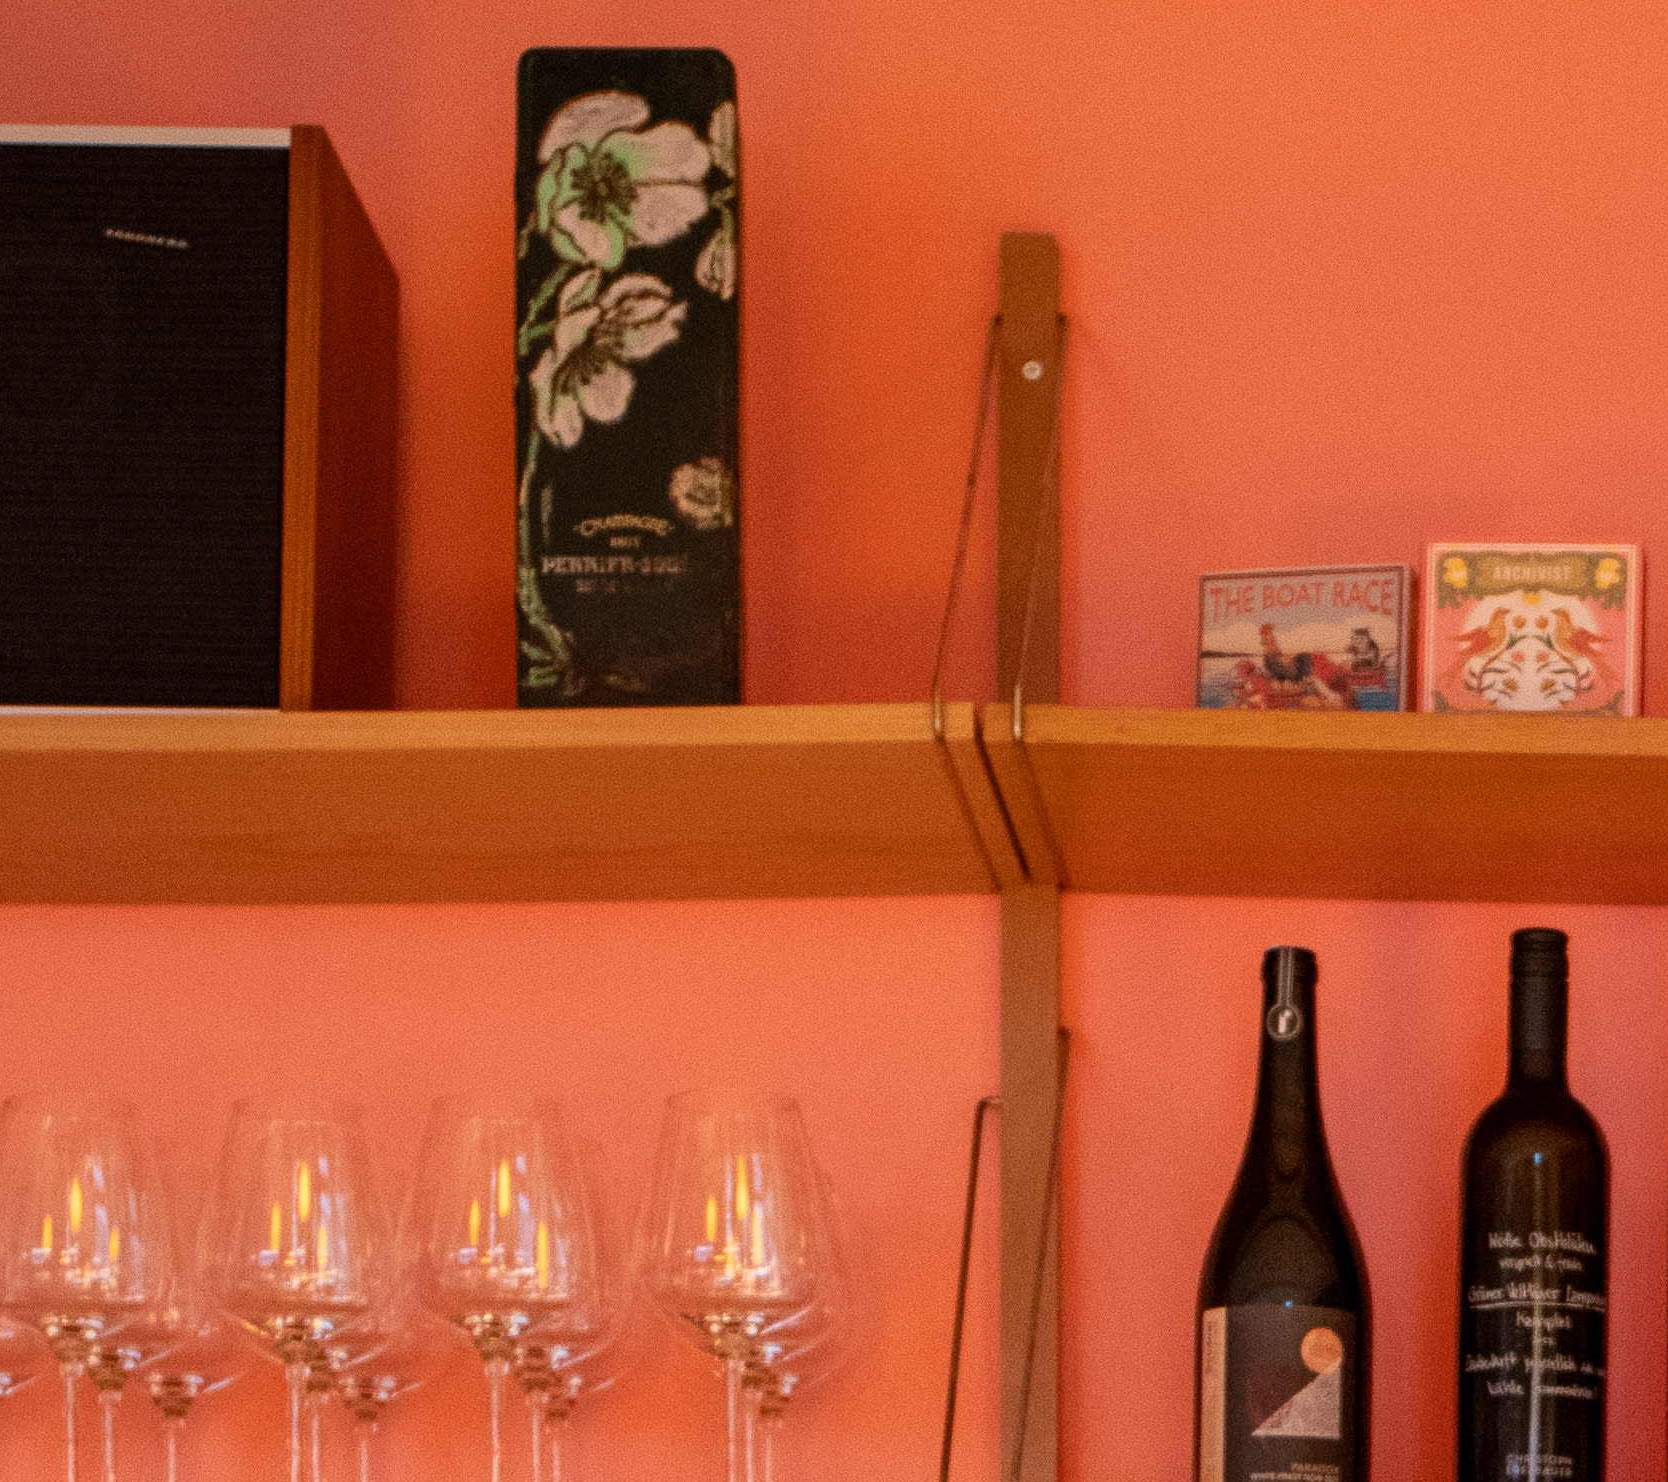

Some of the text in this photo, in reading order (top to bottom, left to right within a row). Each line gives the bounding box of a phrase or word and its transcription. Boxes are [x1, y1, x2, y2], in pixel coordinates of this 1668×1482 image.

[1492, 564, 1572, 582] ARCHIVIST
[1209, 578, 1394, 621] THE BOAT RACE
[1506, 1454, 1573, 1465] CHRTOPH
